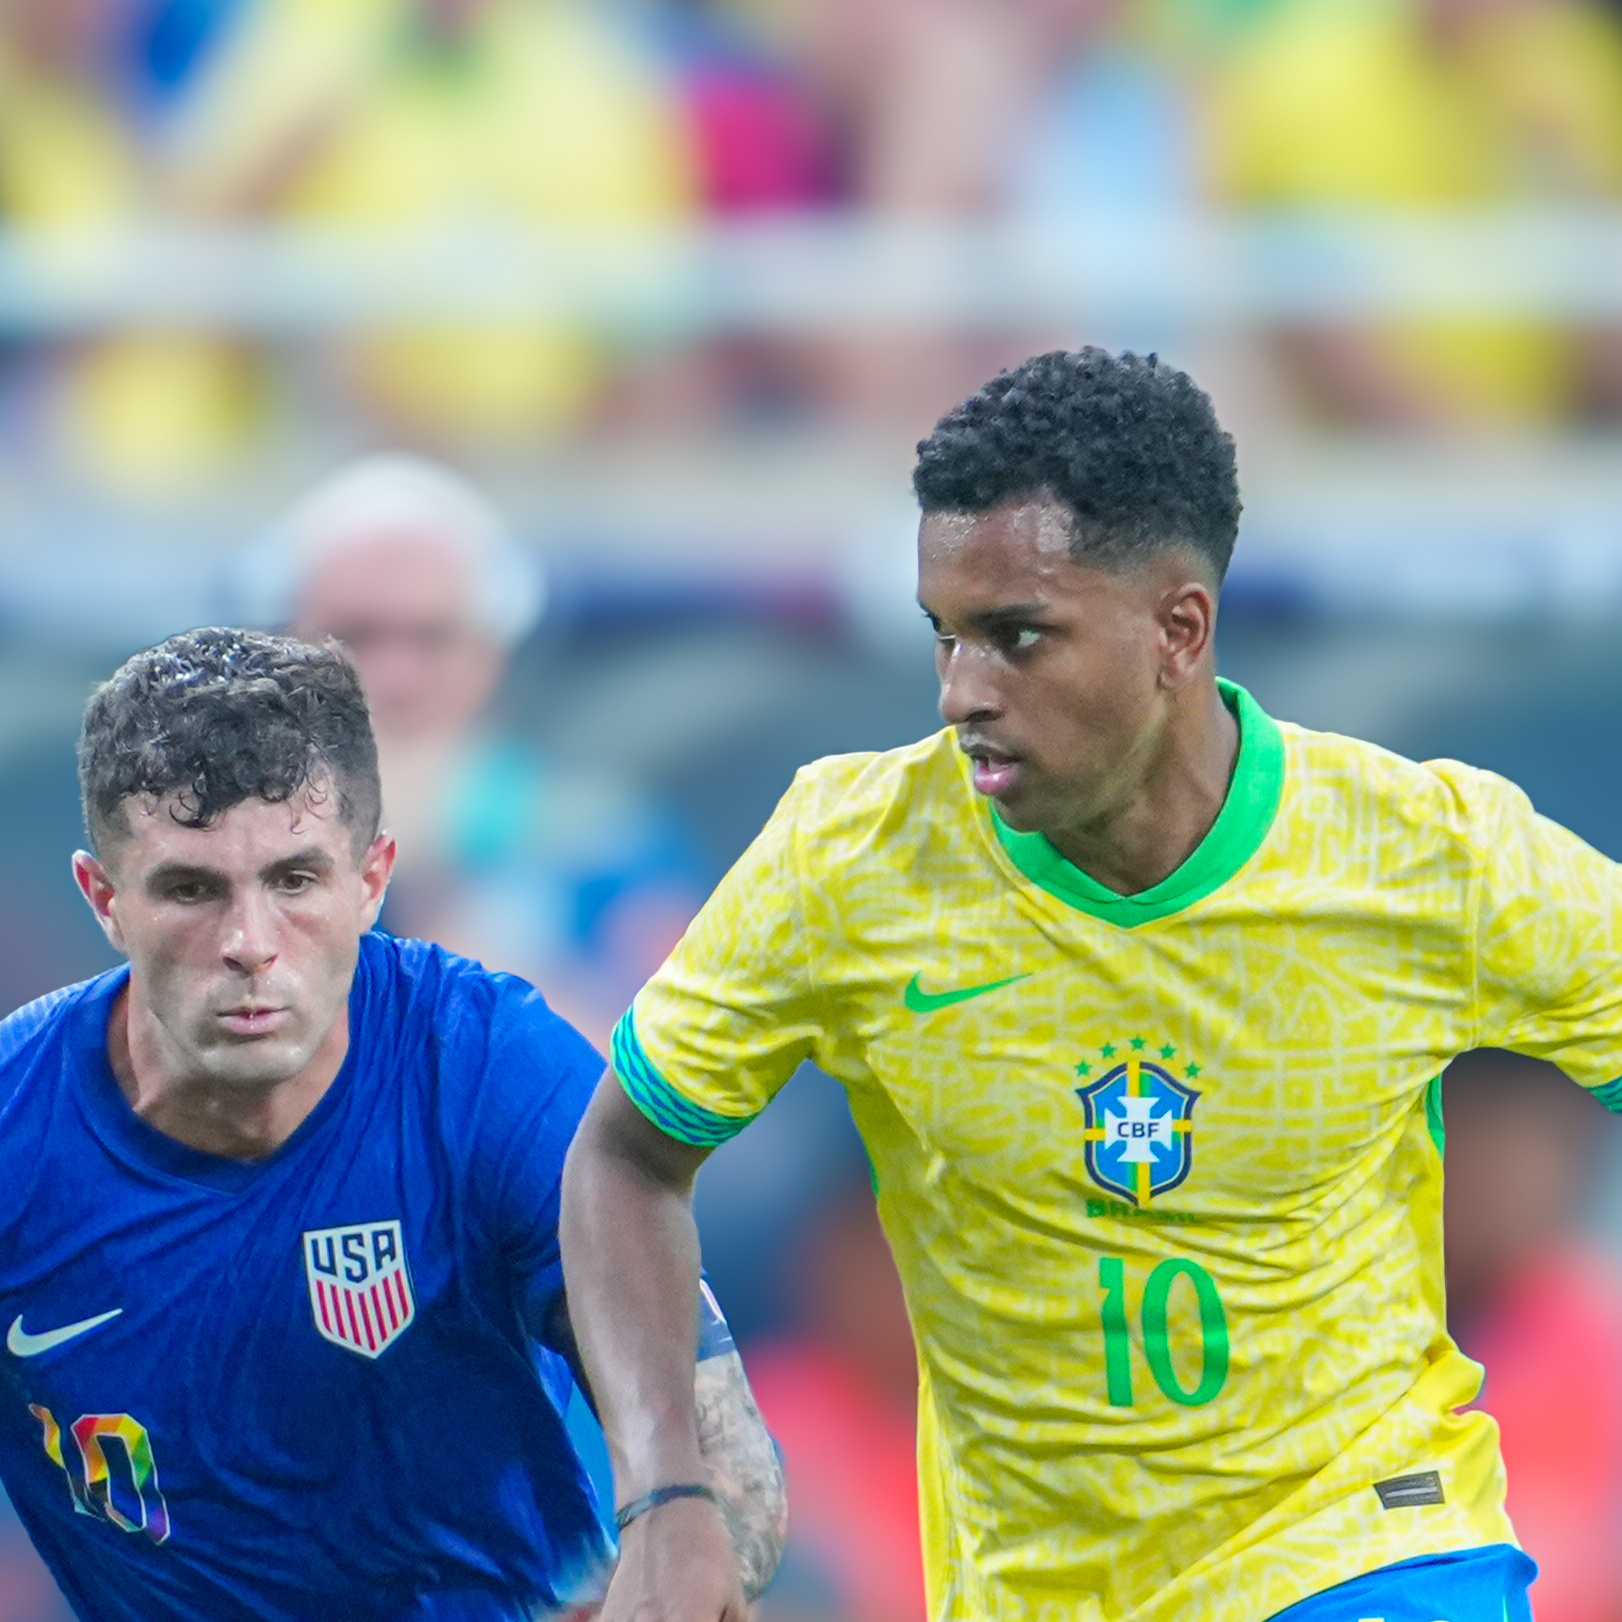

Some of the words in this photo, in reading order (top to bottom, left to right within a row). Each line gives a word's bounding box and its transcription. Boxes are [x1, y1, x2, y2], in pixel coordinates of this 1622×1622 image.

[1117, 1121, 1160, 1139] CBF
[310, 1227, 397, 1284] USA
[1098, 1256, 1231, 1407] 10
